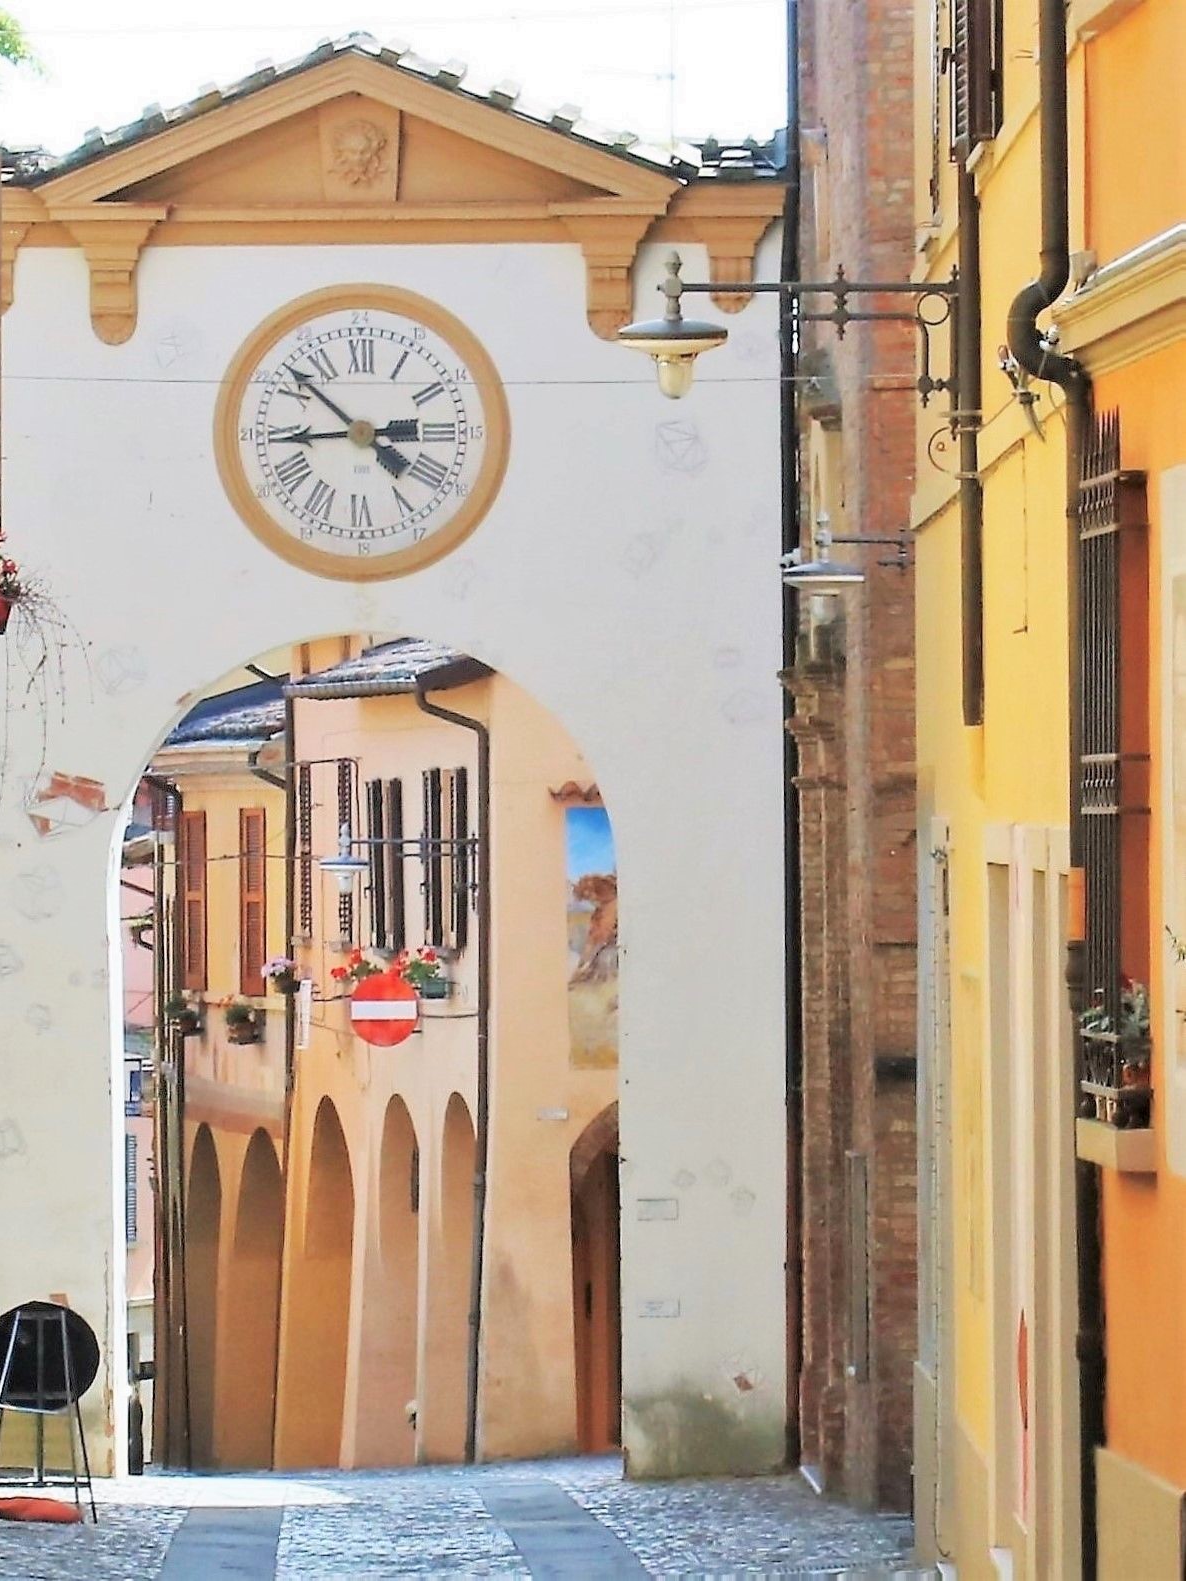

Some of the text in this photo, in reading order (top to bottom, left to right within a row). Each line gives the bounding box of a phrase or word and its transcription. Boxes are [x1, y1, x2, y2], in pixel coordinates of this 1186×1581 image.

[307, 348, 339, 384] XI
[347, 338, 375, 375] XII
[389, 350, 410, 380] I
[411, 380, 446, 407] II
[240, 427, 253, 441] 21
[421, 422, 456, 442] III
[469, 425, 483, 440] 15
[274, 450, 314, 495] VIII
[407, 451, 449, 491] IIII
[303, 479, 336, 521] VII
[350, 493, 373, 528] VI
[391, 485, 415, 518] V
